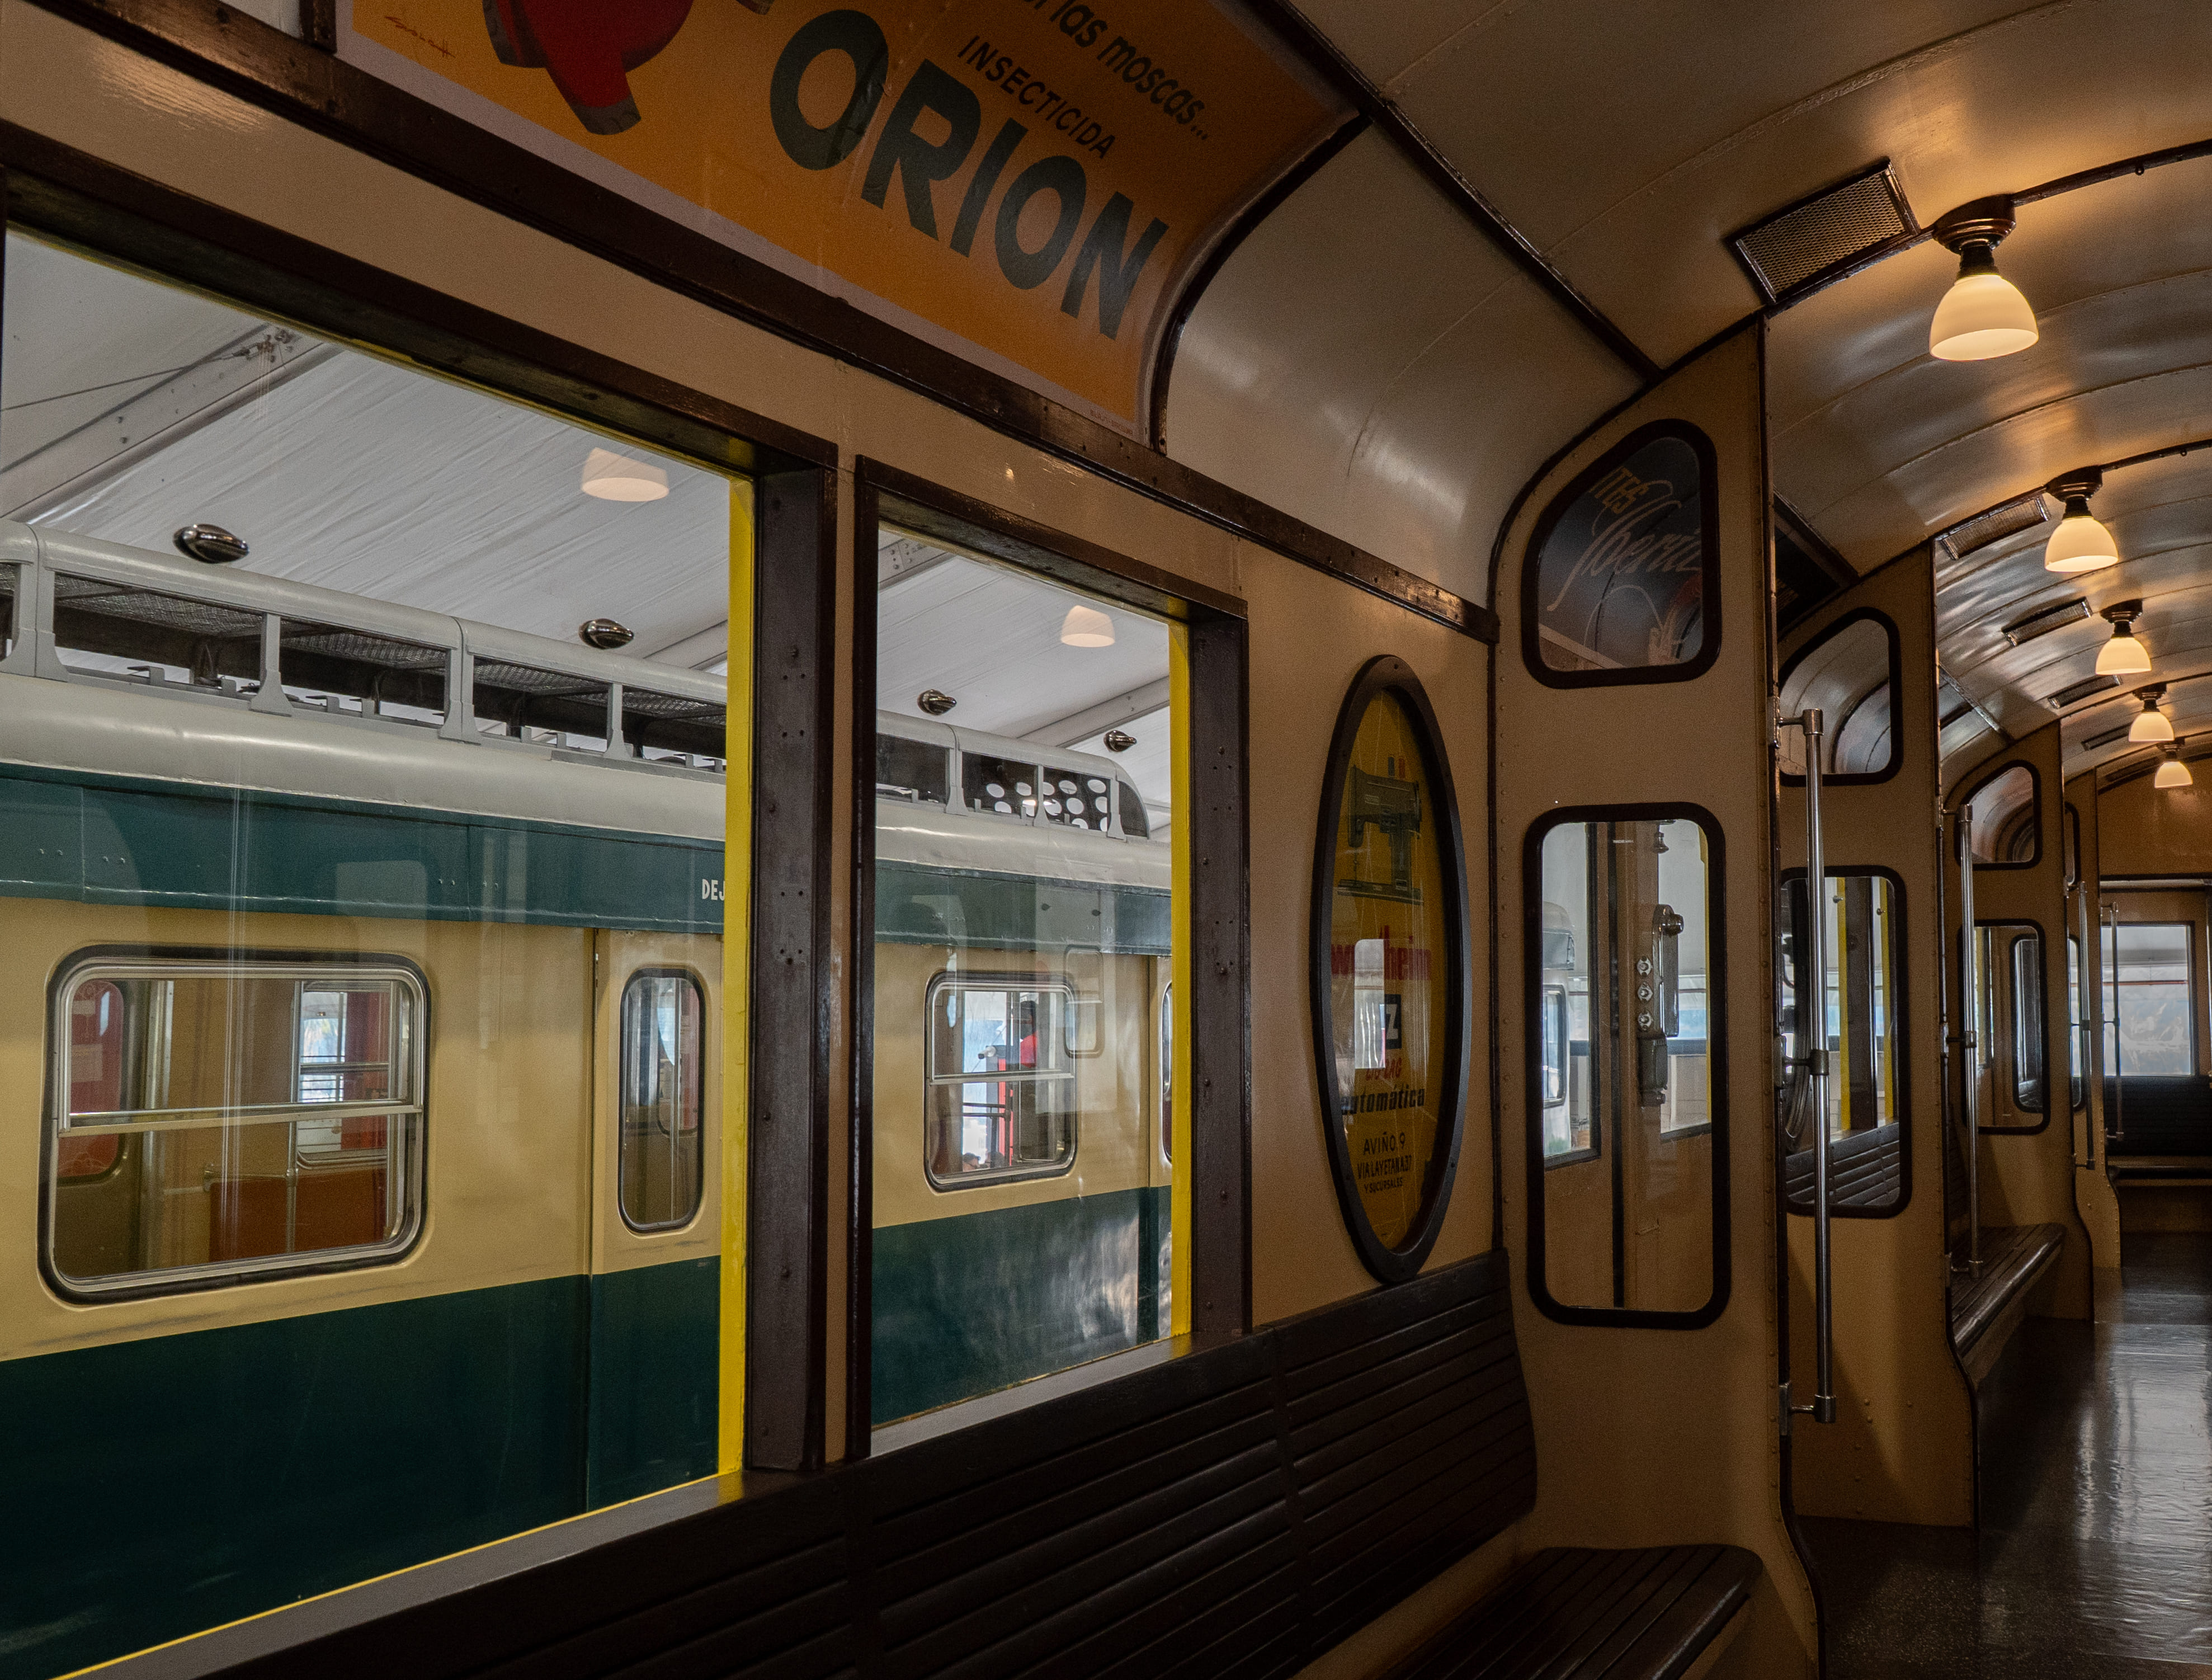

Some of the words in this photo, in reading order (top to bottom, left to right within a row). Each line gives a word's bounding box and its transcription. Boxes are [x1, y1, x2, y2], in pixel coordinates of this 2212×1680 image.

[1050, 0, 1109, 48] las
[1097, 36, 1208, 141] moscas...
[957, 36, 1116, 159] INSECTICIDA
[770, 9, 1169, 340] ORION
[1331, 925, 1432, 981] wheim
[1341, 1084, 1425, 1116] automática
[1399, 1132, 1406, 1150] 9
[1369, 1177, 1403, 1193] SUCURSALES
[1370, 1156, 1404, 1177] LAYETANA
